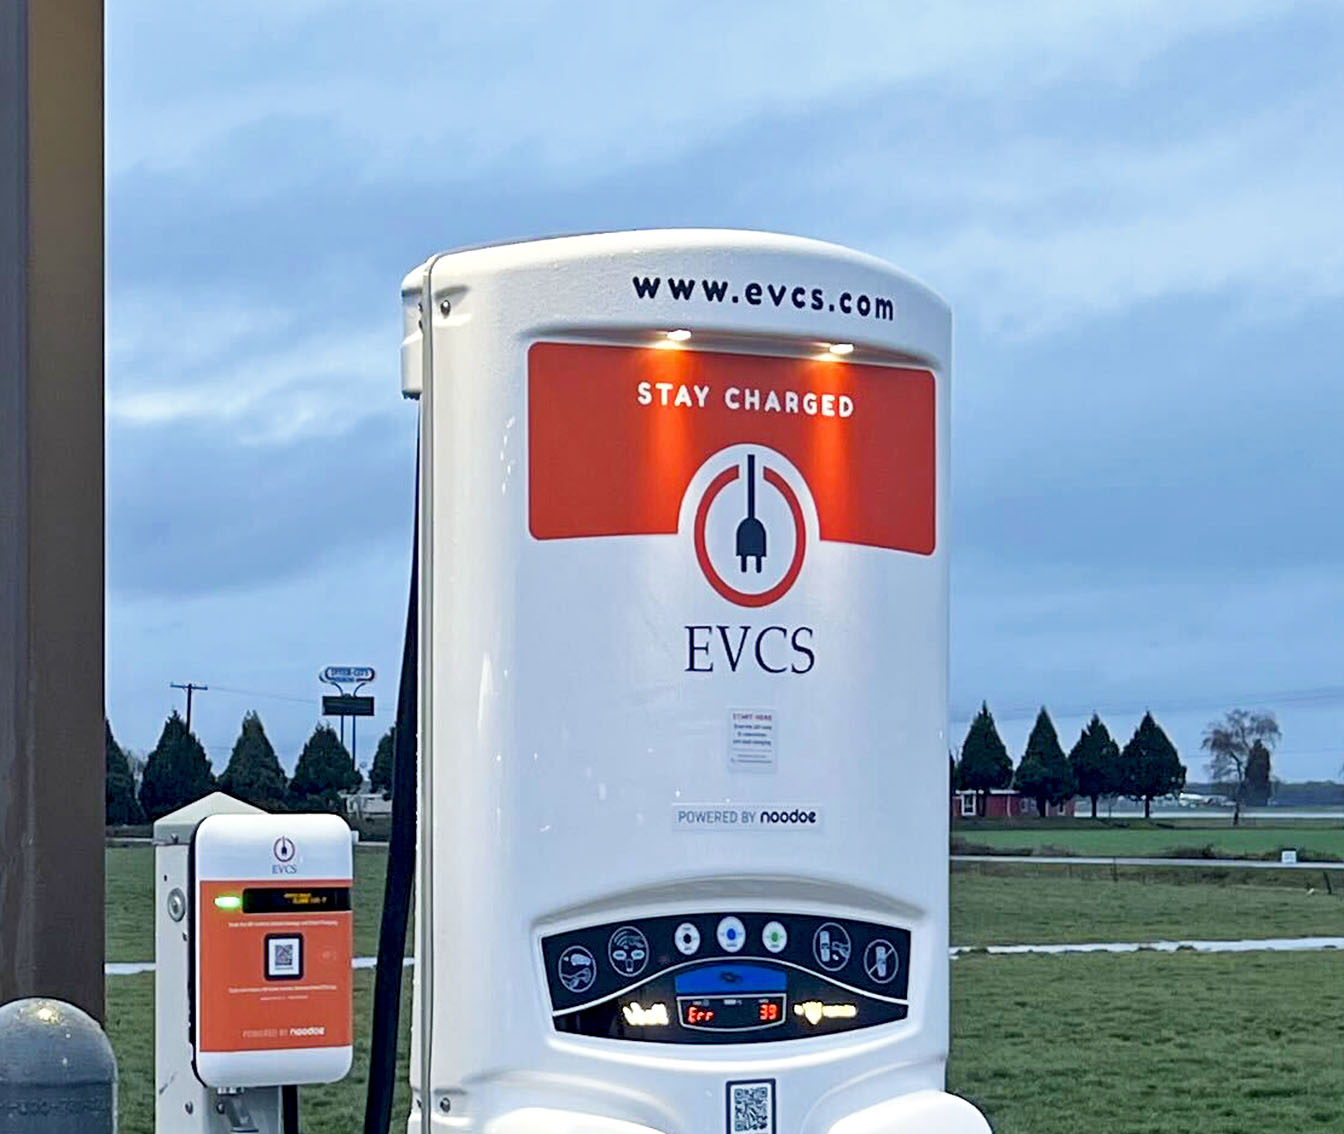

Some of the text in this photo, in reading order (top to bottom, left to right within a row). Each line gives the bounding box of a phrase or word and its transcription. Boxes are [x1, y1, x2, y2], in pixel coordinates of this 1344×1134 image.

[632, 276, 894, 321] www.evcs.com
[637, 381, 854, 417] STAY CHARGED
[684, 625, 815, 674] EVCS
[678, 808, 816, 824] POWERED BY noodoe
[272, 864, 297, 875] EVCS
[759, 1003, 779, 1020] 39
